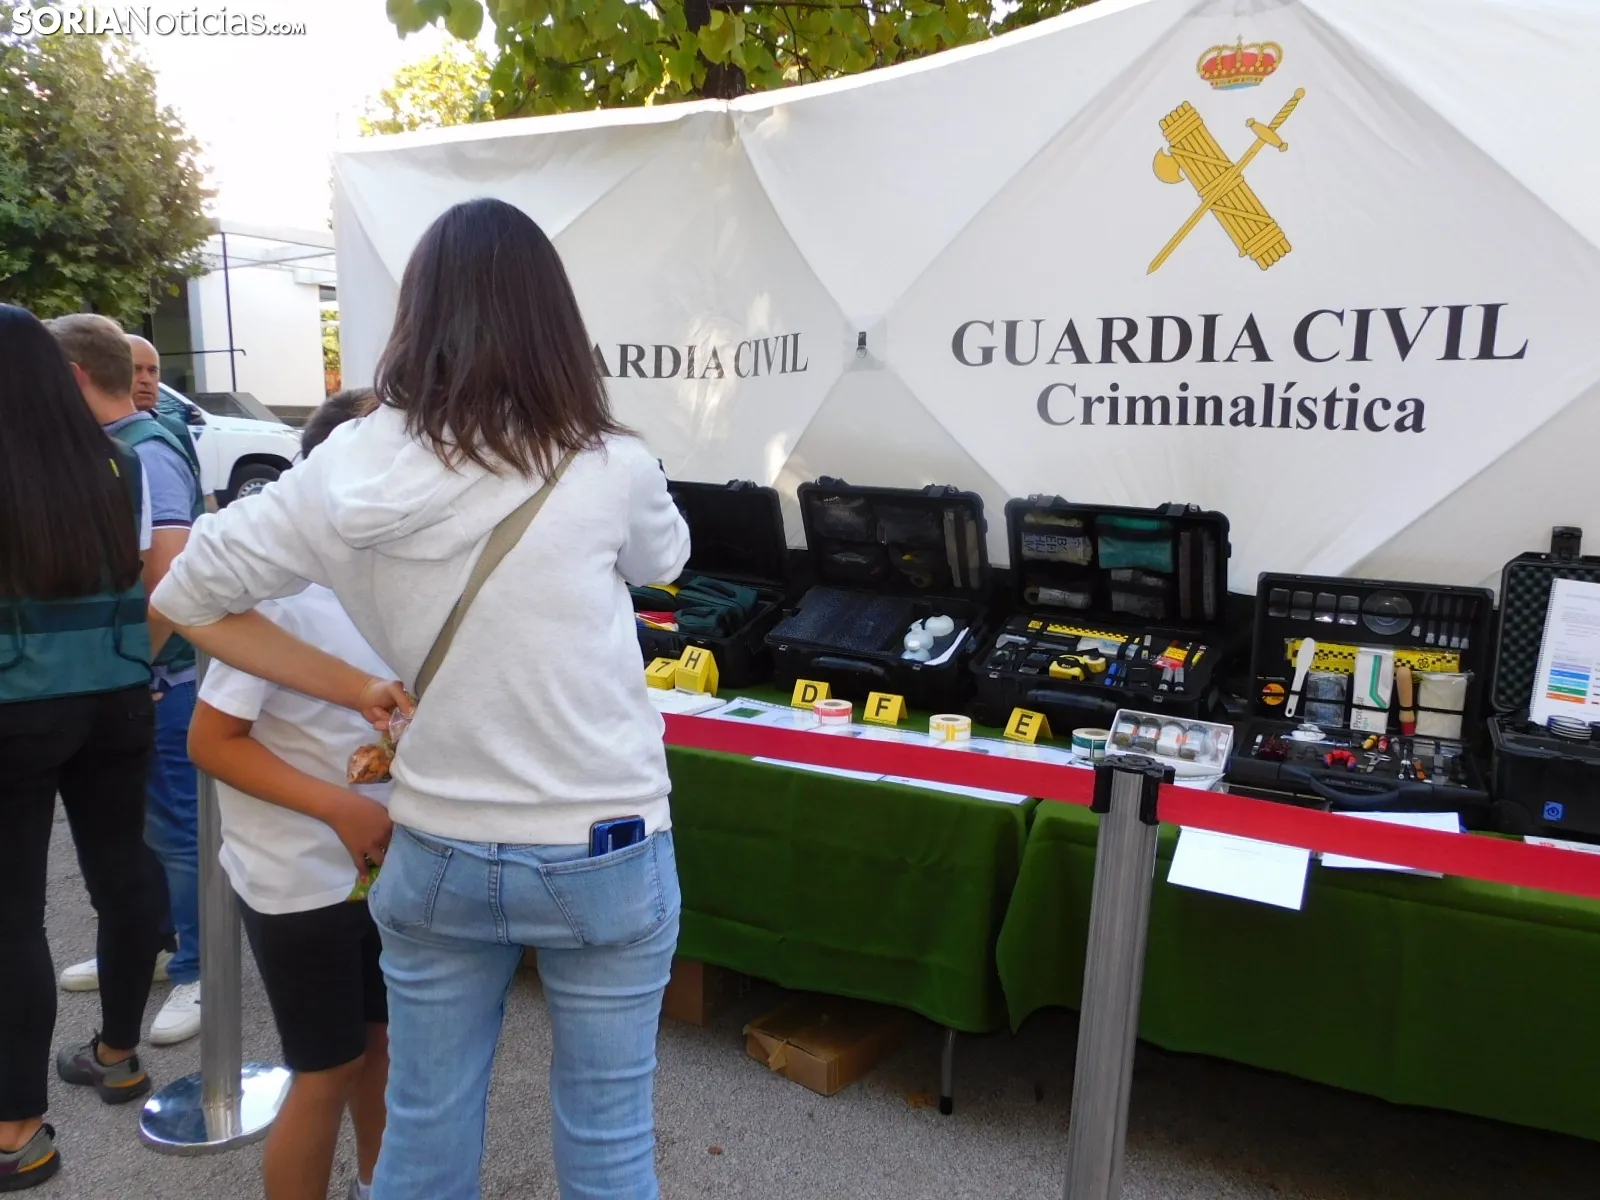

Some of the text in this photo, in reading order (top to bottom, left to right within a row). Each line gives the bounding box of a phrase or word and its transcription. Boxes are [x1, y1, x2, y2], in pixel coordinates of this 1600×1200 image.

[950, 303, 1529, 367] GUARDIA CIVIL
[592, 332, 809, 380] ARDIA CIVIL
[1036, 381, 1427, 434] Criminalística
[655, 660, 671, 673] 7
[684, 650, 702, 670] H
[801, 683, 819, 703] D
[875, 697, 892, 717] F
[1014, 713, 1034, 737] E
